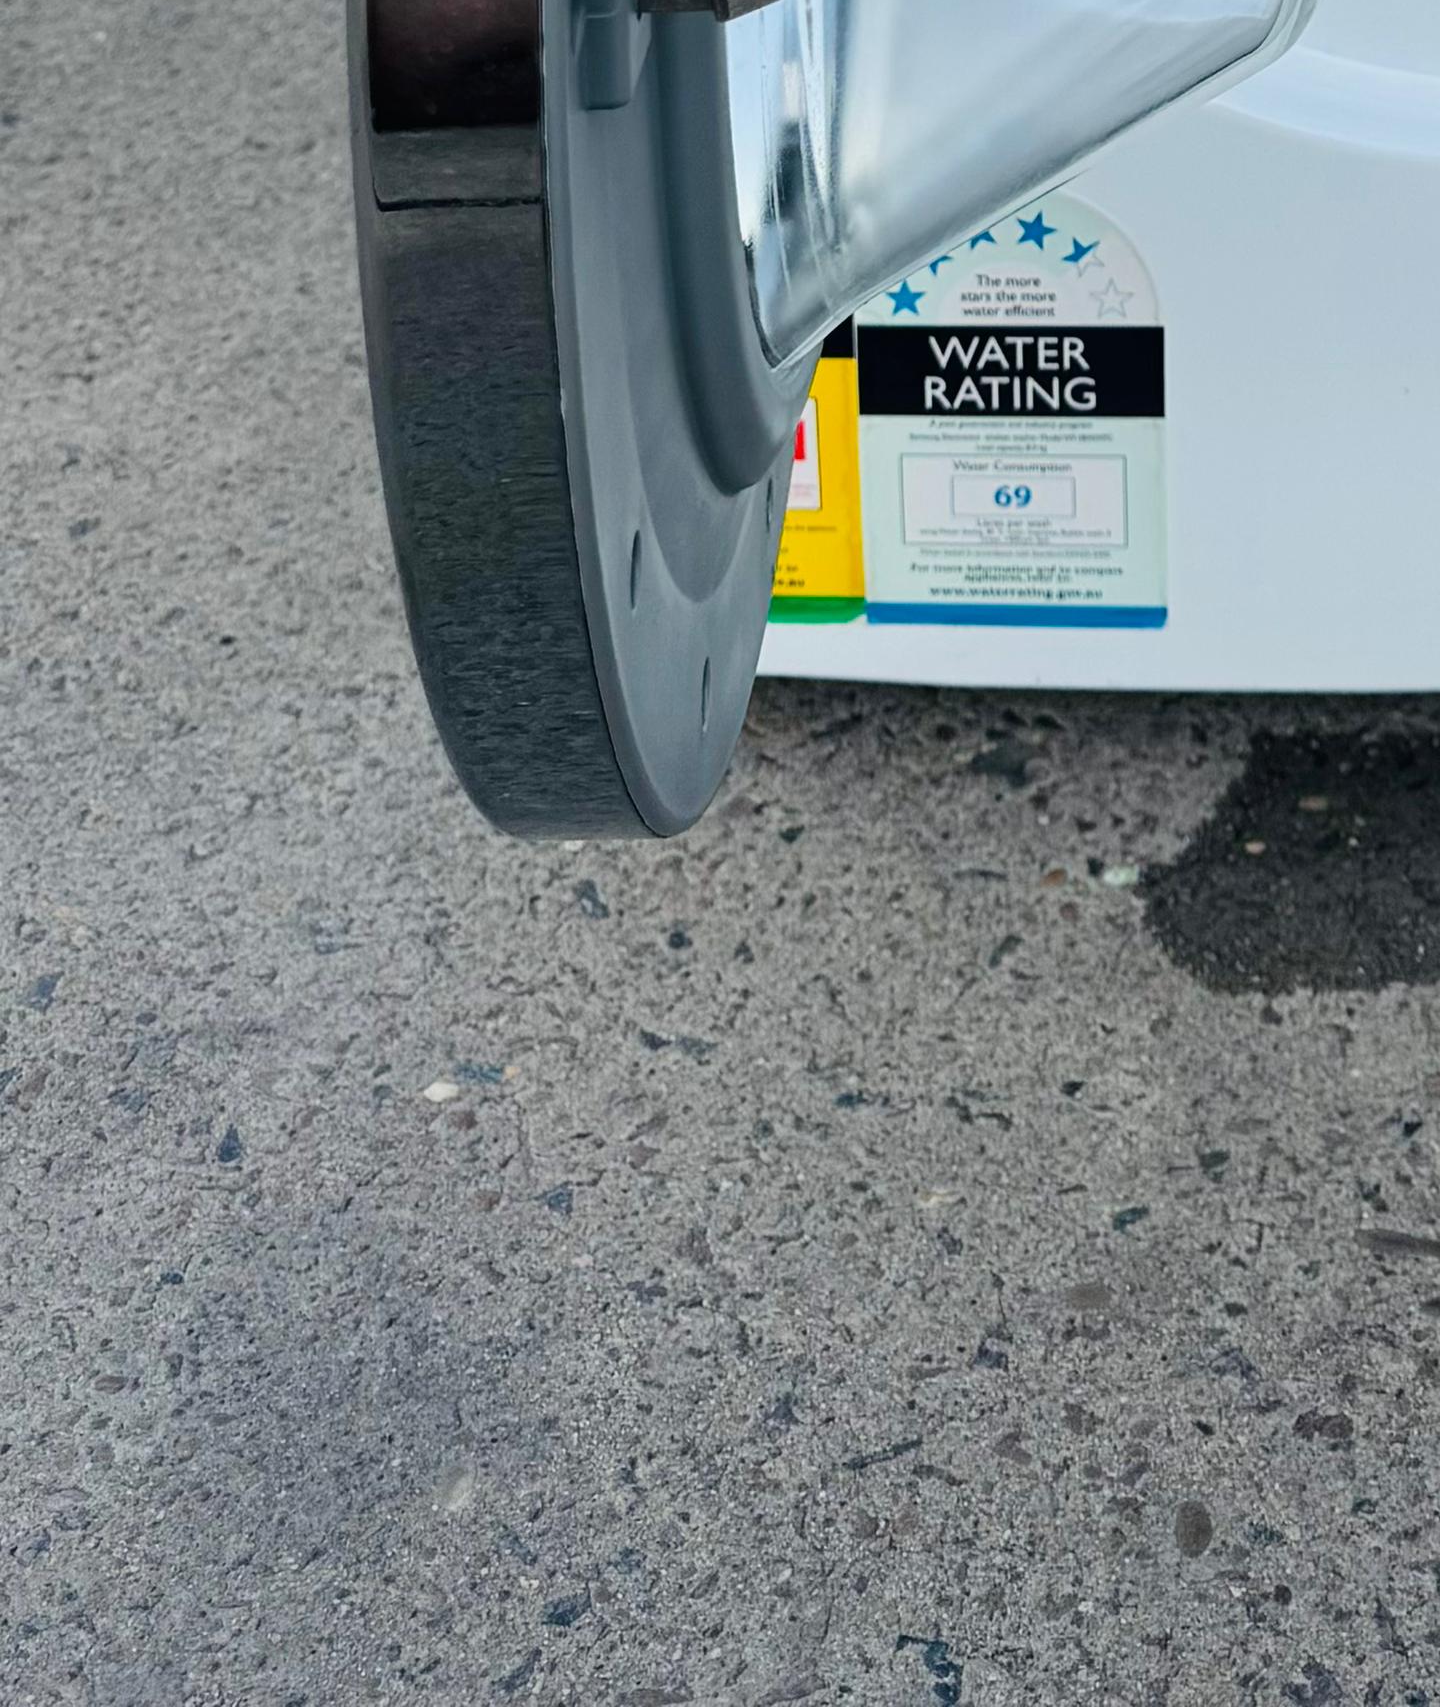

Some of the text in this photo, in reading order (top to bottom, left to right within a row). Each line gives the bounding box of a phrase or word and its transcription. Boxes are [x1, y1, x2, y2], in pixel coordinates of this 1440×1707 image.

[976, 273, 1041, 287] The more
[960, 289, 1056, 302] stars the more
[963, 304, 1055, 317] water efficient
[928, 336, 1090, 371] WATER
[924, 376, 1097, 411] RATING
[994, 484, 1032, 507] 69
